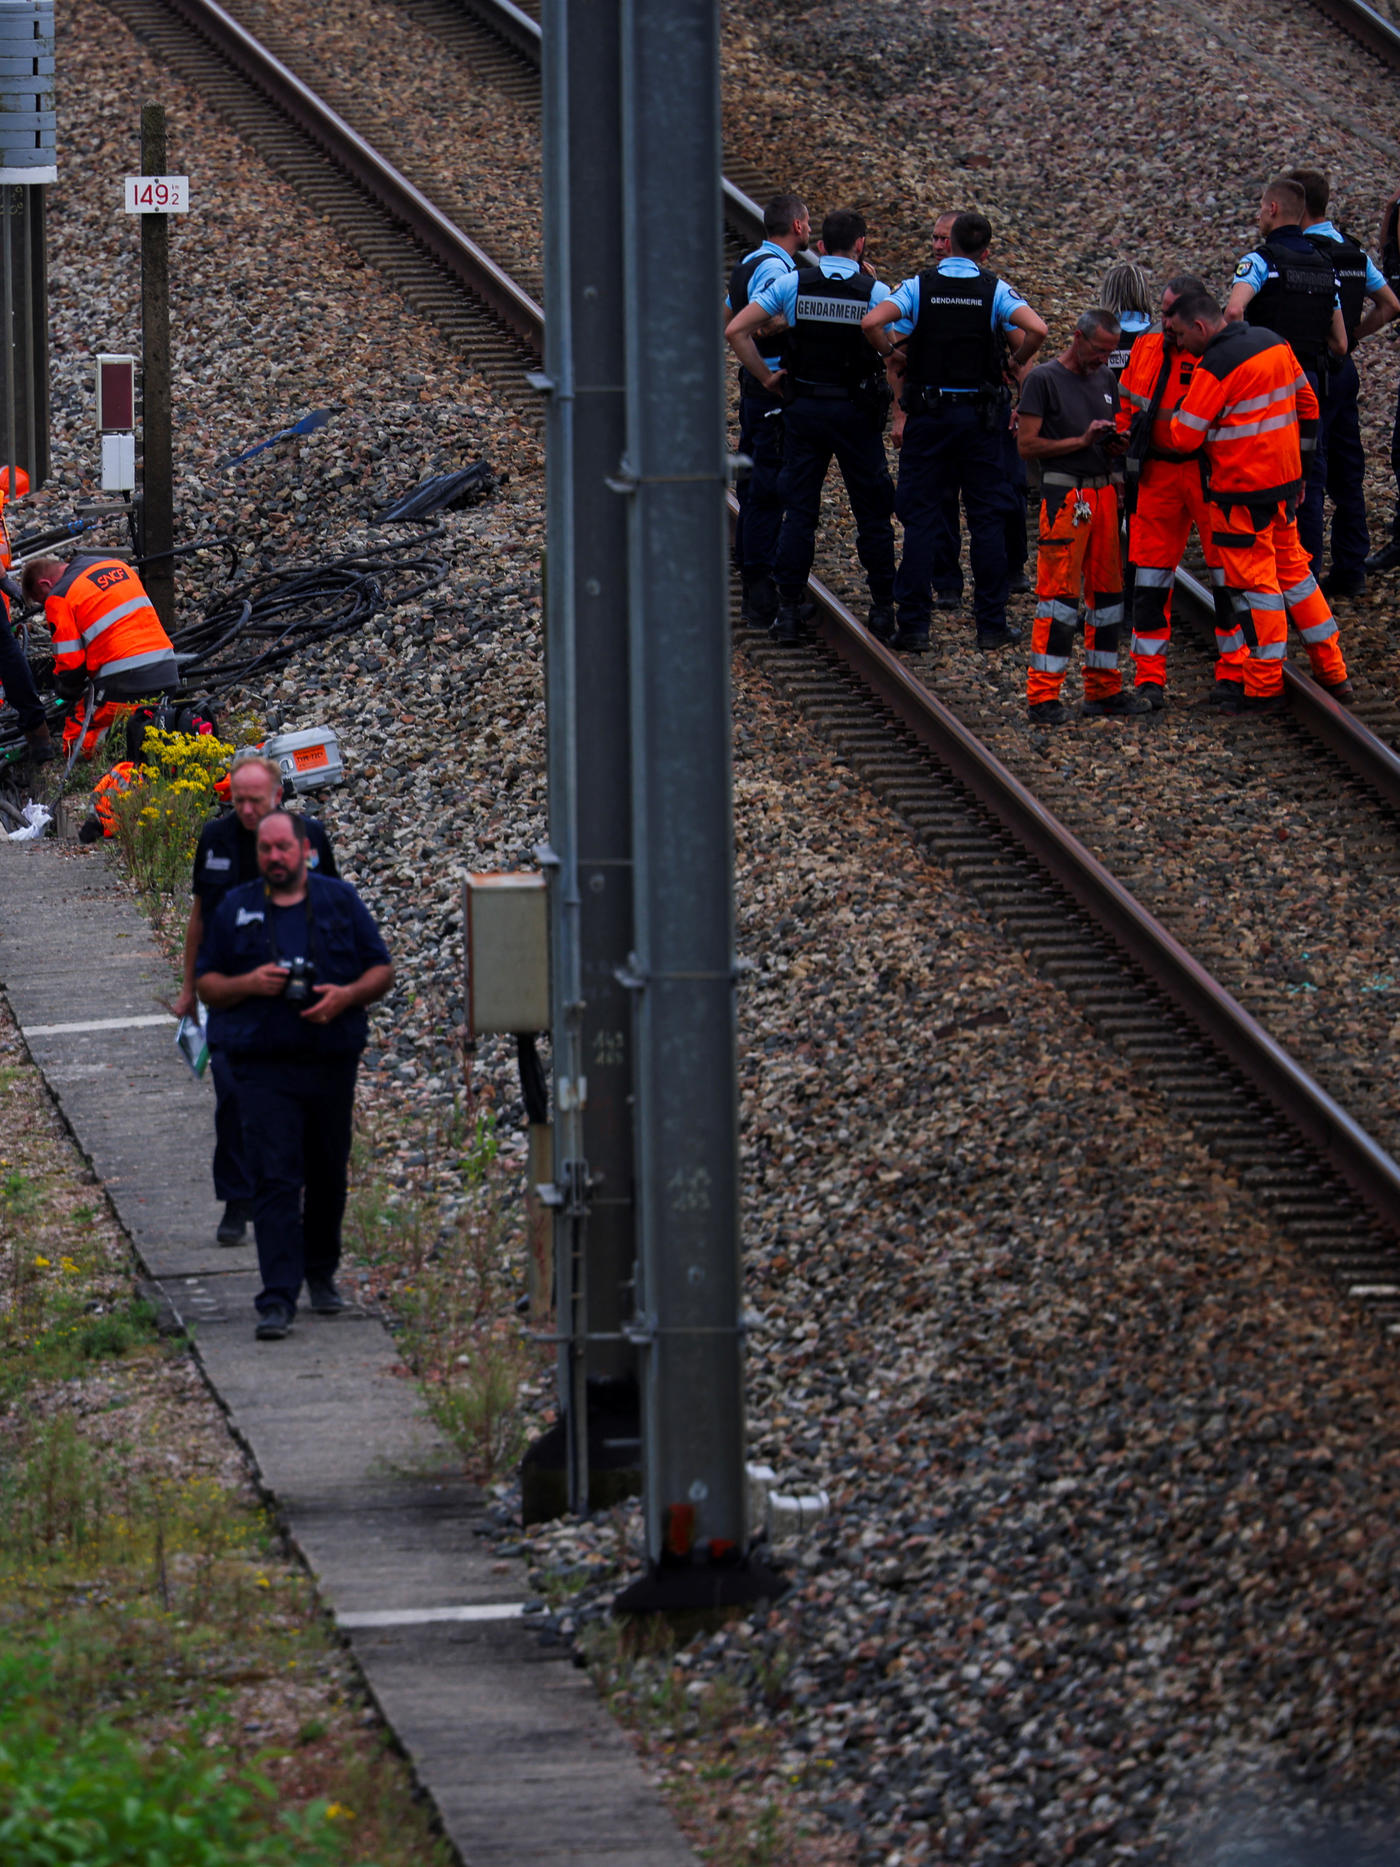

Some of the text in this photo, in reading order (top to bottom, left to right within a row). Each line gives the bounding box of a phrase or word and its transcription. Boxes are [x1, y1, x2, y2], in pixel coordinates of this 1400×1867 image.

[798, 300, 866, 320] GENDARMERIE
[931, 297, 982, 306] GENDARMERIE
[97, 569, 124, 589] SNCF
